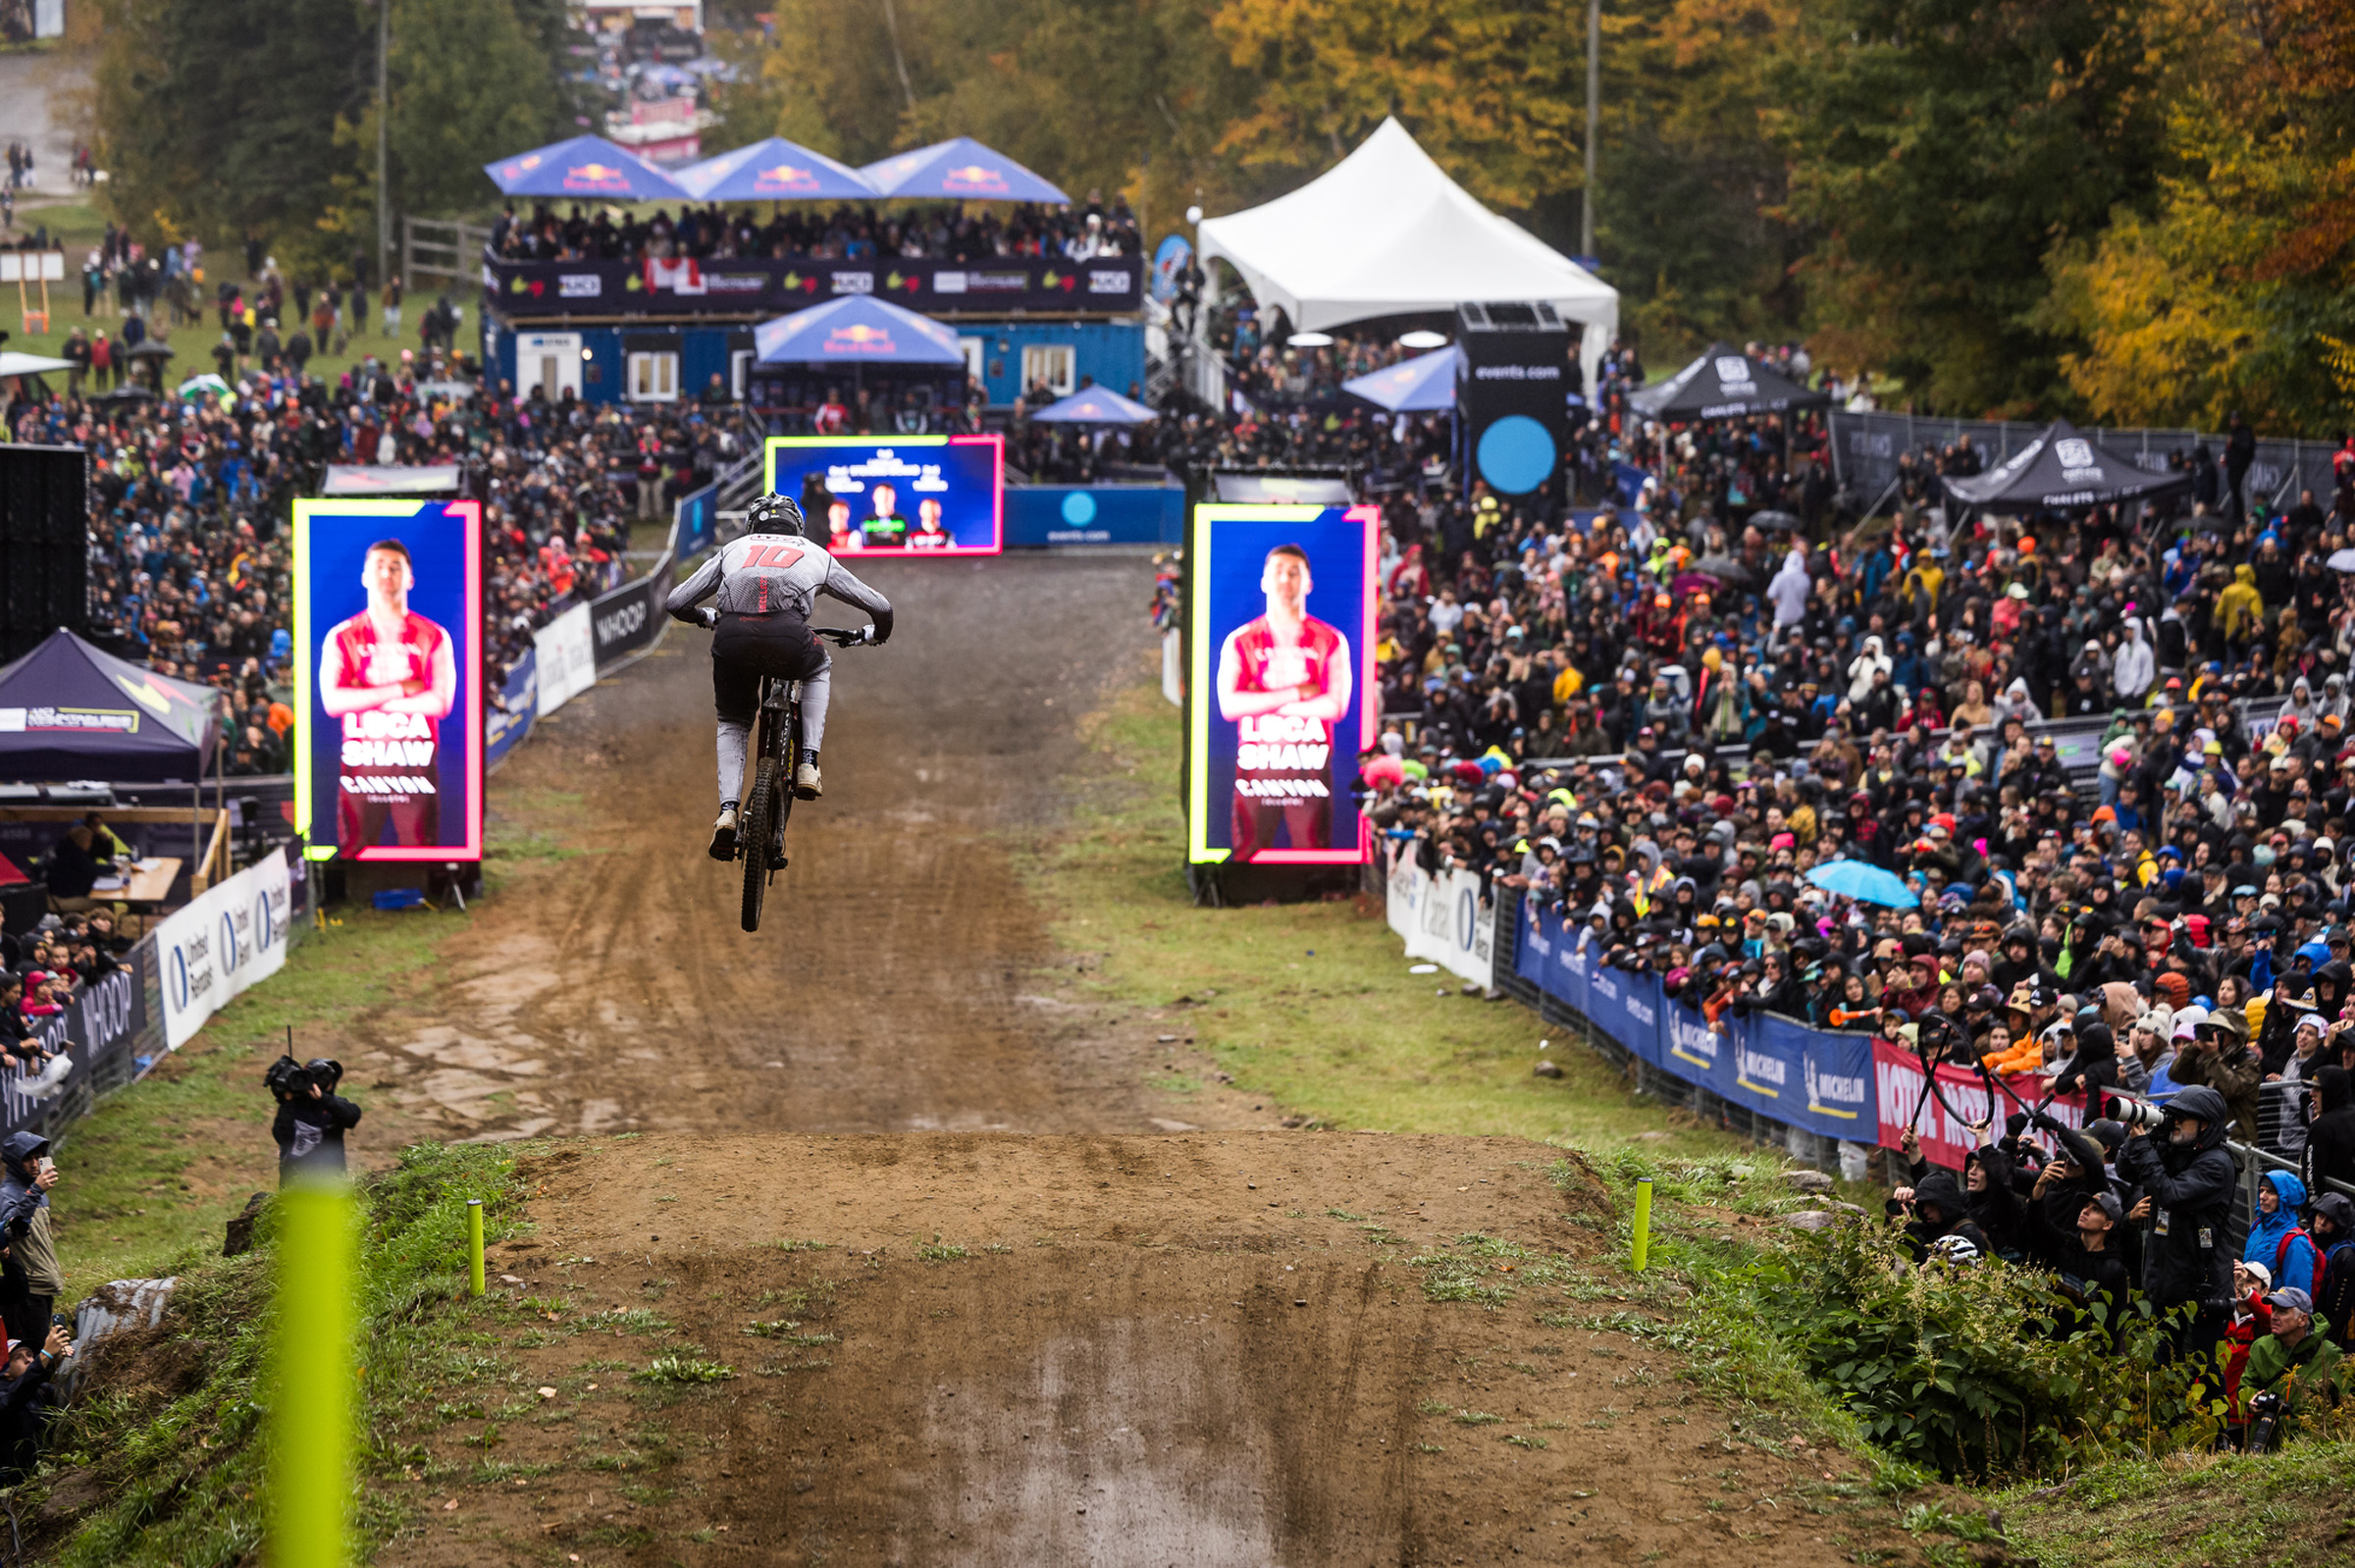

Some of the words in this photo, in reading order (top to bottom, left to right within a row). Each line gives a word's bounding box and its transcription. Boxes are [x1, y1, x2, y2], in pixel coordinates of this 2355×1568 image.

[1475, 365, 1560, 381] events.com
[742, 545, 805, 568] 10
[596, 601, 648, 646] WHOOP
[343, 712, 432, 739] LUCA
[1240, 714, 1328, 742] LUCA
[340, 740, 436, 766] SHAW
[1236, 743, 1330, 770] SHAW
[340, 775, 437, 794] CANYON
[1234, 778, 1331, 797] CANYON
[81, 971, 132, 1059] WHOOP
[1747, 1051, 1786, 1085] MICHELIN
[1819, 1072, 1864, 1104] MICHELIN
[1876, 1061, 1937, 1140] MOTUL
